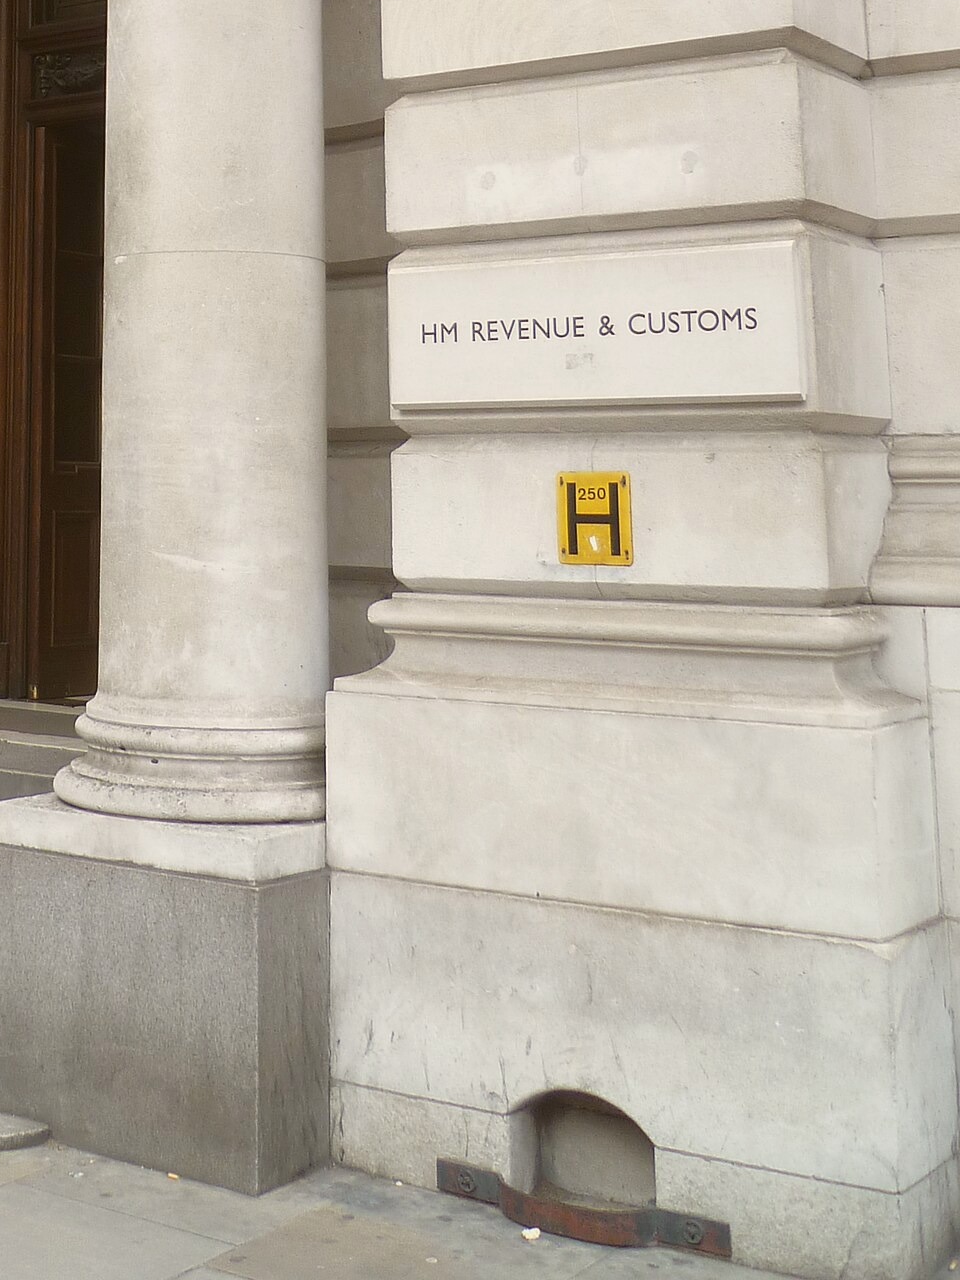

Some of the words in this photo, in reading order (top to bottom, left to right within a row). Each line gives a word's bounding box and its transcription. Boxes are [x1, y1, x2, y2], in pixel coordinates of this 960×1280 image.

[421, 322, 458, 344] HM
[471, 316, 585, 342] REVENUE
[598, 315, 616, 336] &
[628, 307, 758, 335] CUSTOMS
[577, 487, 607, 501] 250
[566, 482, 621, 556] H
